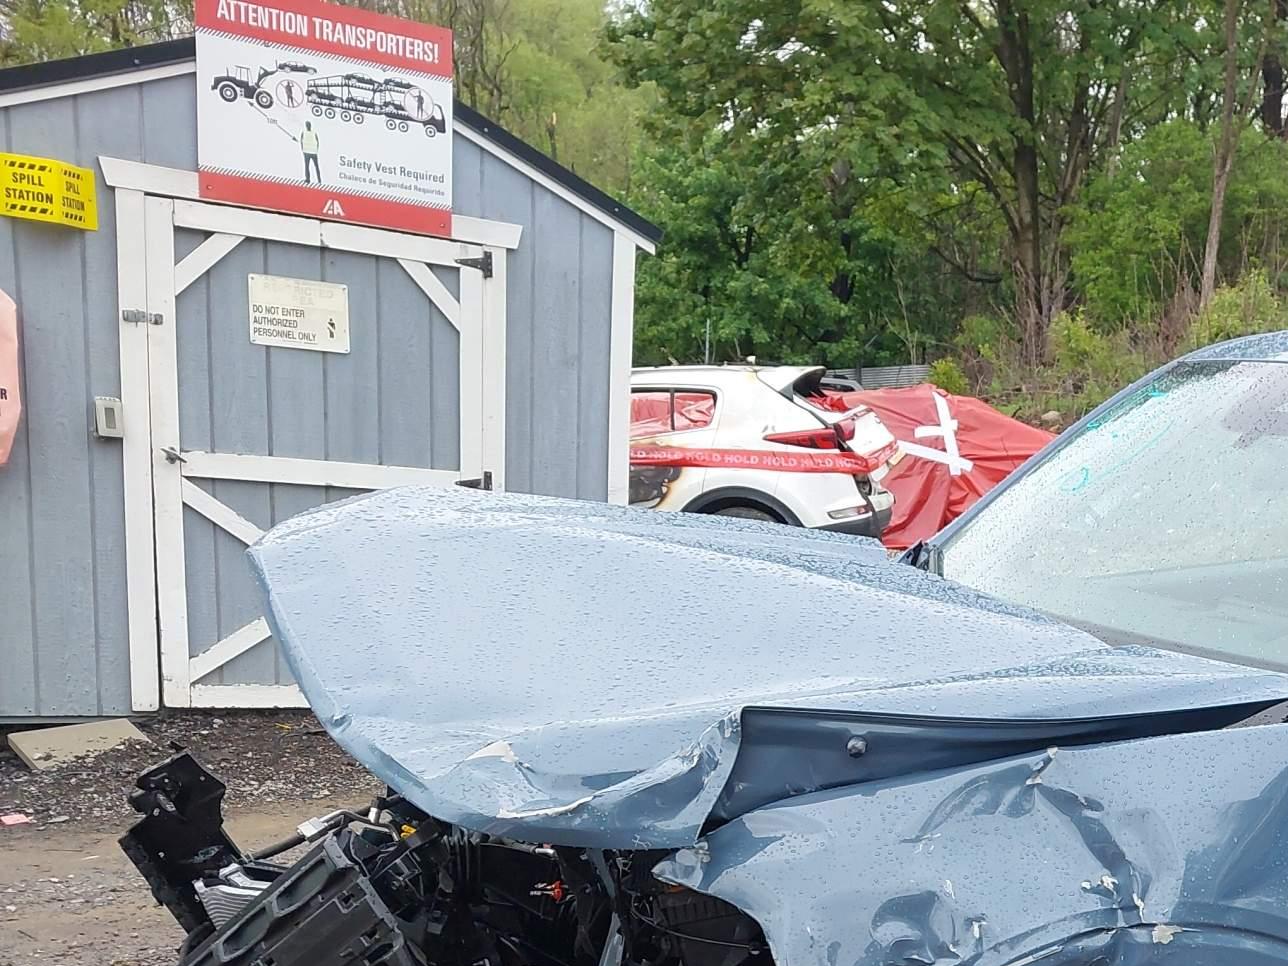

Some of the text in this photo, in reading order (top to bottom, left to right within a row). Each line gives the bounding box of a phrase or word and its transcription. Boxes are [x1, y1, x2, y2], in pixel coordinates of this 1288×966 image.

[217, 0, 440, 64] ATTENTION TRANSPORTERS!
[339, 155, 445, 184] Safety Vest Required
[12, 172, 45, 187] SPILL
[368, 176, 377, 185] de
[379, 178, 412, 191] Seguridad
[65, 181, 80, 195] SPILL
[5, 187, 53, 205] STATION
[62, 196, 85, 211] STATION
[252, 304, 305, 318] DO NOT ENTER
[253, 316, 298, 328] AUTHORIZED
[253, 327, 297, 339] PERSONNEL
[298, 332, 316, 342] ONLY
[688, 452, 721, 464] HOLD
[724, 454, 759, 466] HOLD
[763, 455, 797, 468] HOLD
